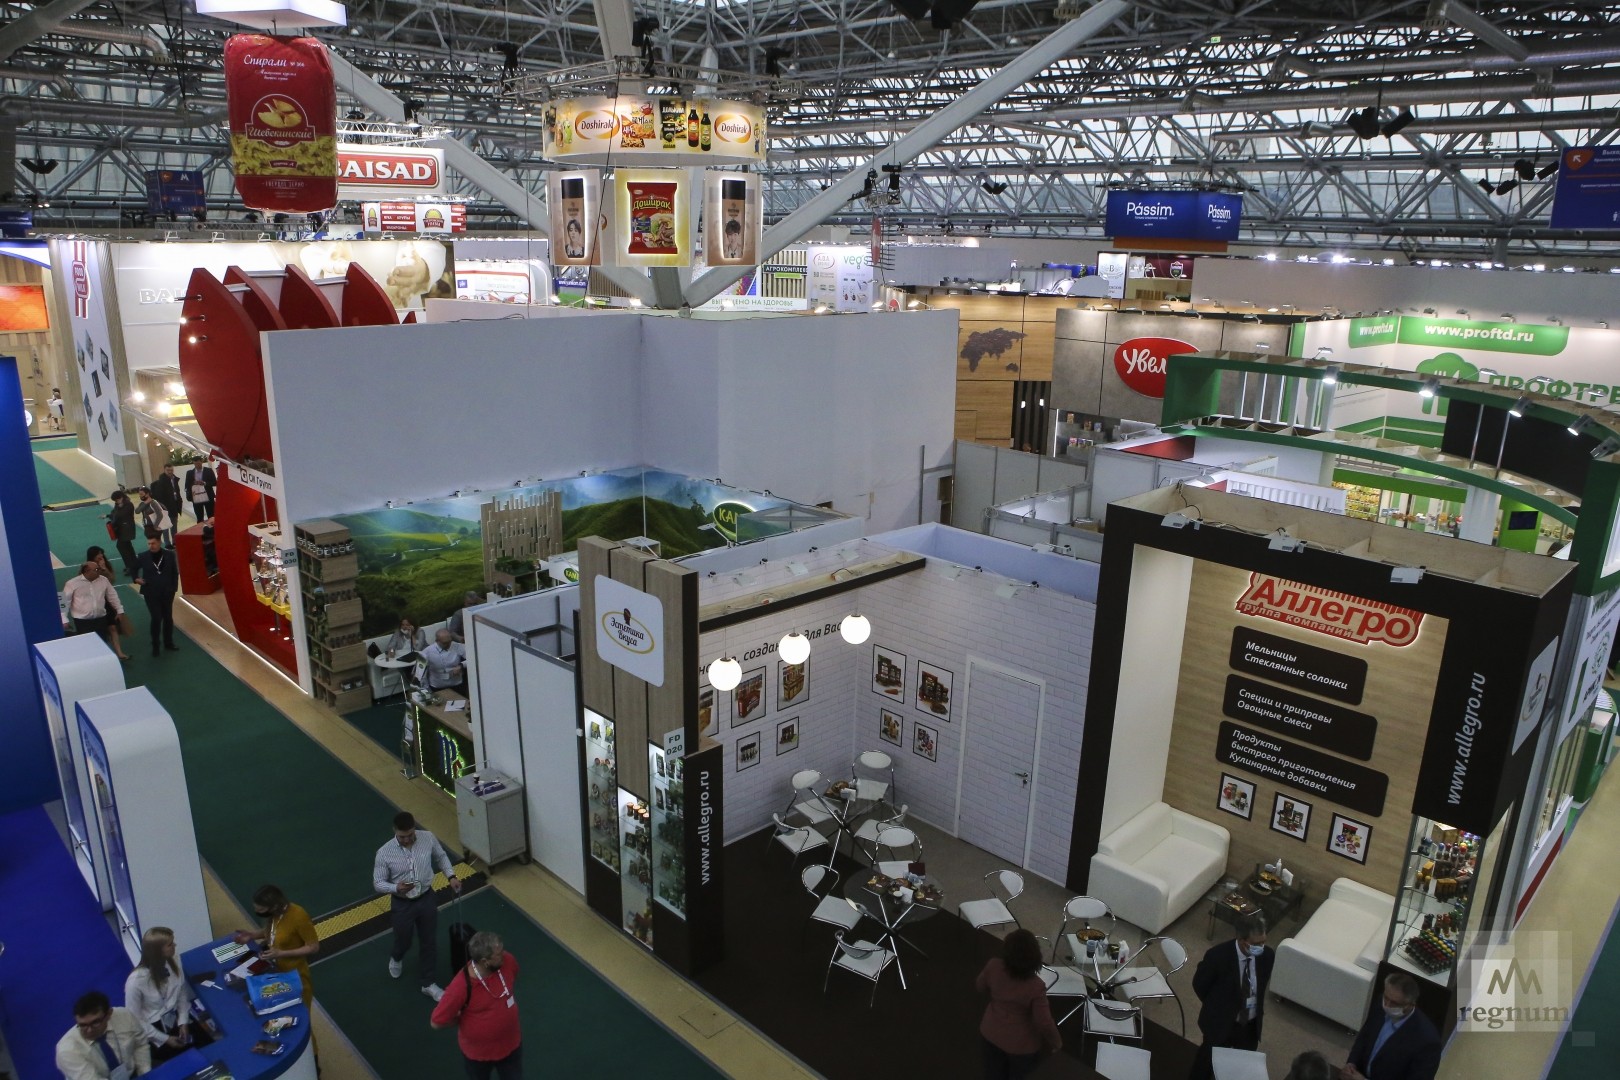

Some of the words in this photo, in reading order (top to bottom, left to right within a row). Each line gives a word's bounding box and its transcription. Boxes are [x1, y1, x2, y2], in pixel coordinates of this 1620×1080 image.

[243, 54, 287, 67] Спирали
[248, 126, 312, 138] Шебекинские
[581, 119, 614, 130] Doshirak
[721, 123, 748, 134] Doshirak
[632, 199, 671, 211] Доширак
[139, 288, 187, 303] BAI
[1425, 323, 1534, 343] www.proftd.ru
[1122, 348, 1167, 375] Увел
[1238, 602, 1281, 619] группа
[1285, 612, 1353, 639] компаний
[1250, 579, 1411, 639] Аллегро
[610, 617, 644, 640] Эстетика
[743, 642, 780, 661] создан
[804, 629, 821, 641] для
[1246, 641, 1297, 663] Мельницы
[1244, 653, 1305, 677] Стеклянные
[1306, 670, 1348, 690] солонки
[1237, 700, 1282, 721] Овощные
[1283, 715, 1312, 731] смеси
[1239, 688, 1273, 707] Специи
[1283, 702, 1332, 724] приправы
[666, 744, 683, 756] 020
[668, 733, 681, 744] FD
[1233, 729, 1282, 752] Продукты
[1448, 672, 1486, 805] www.allegro.ru
[1229, 752, 1286, 779] Кулинарные
[1287, 771, 1328, 793] добавки
[1231, 741, 1277, 762] быстрого
[1278, 758, 1356, 790] приготовления
[697, 771, 713, 885] www.allegro.ru
